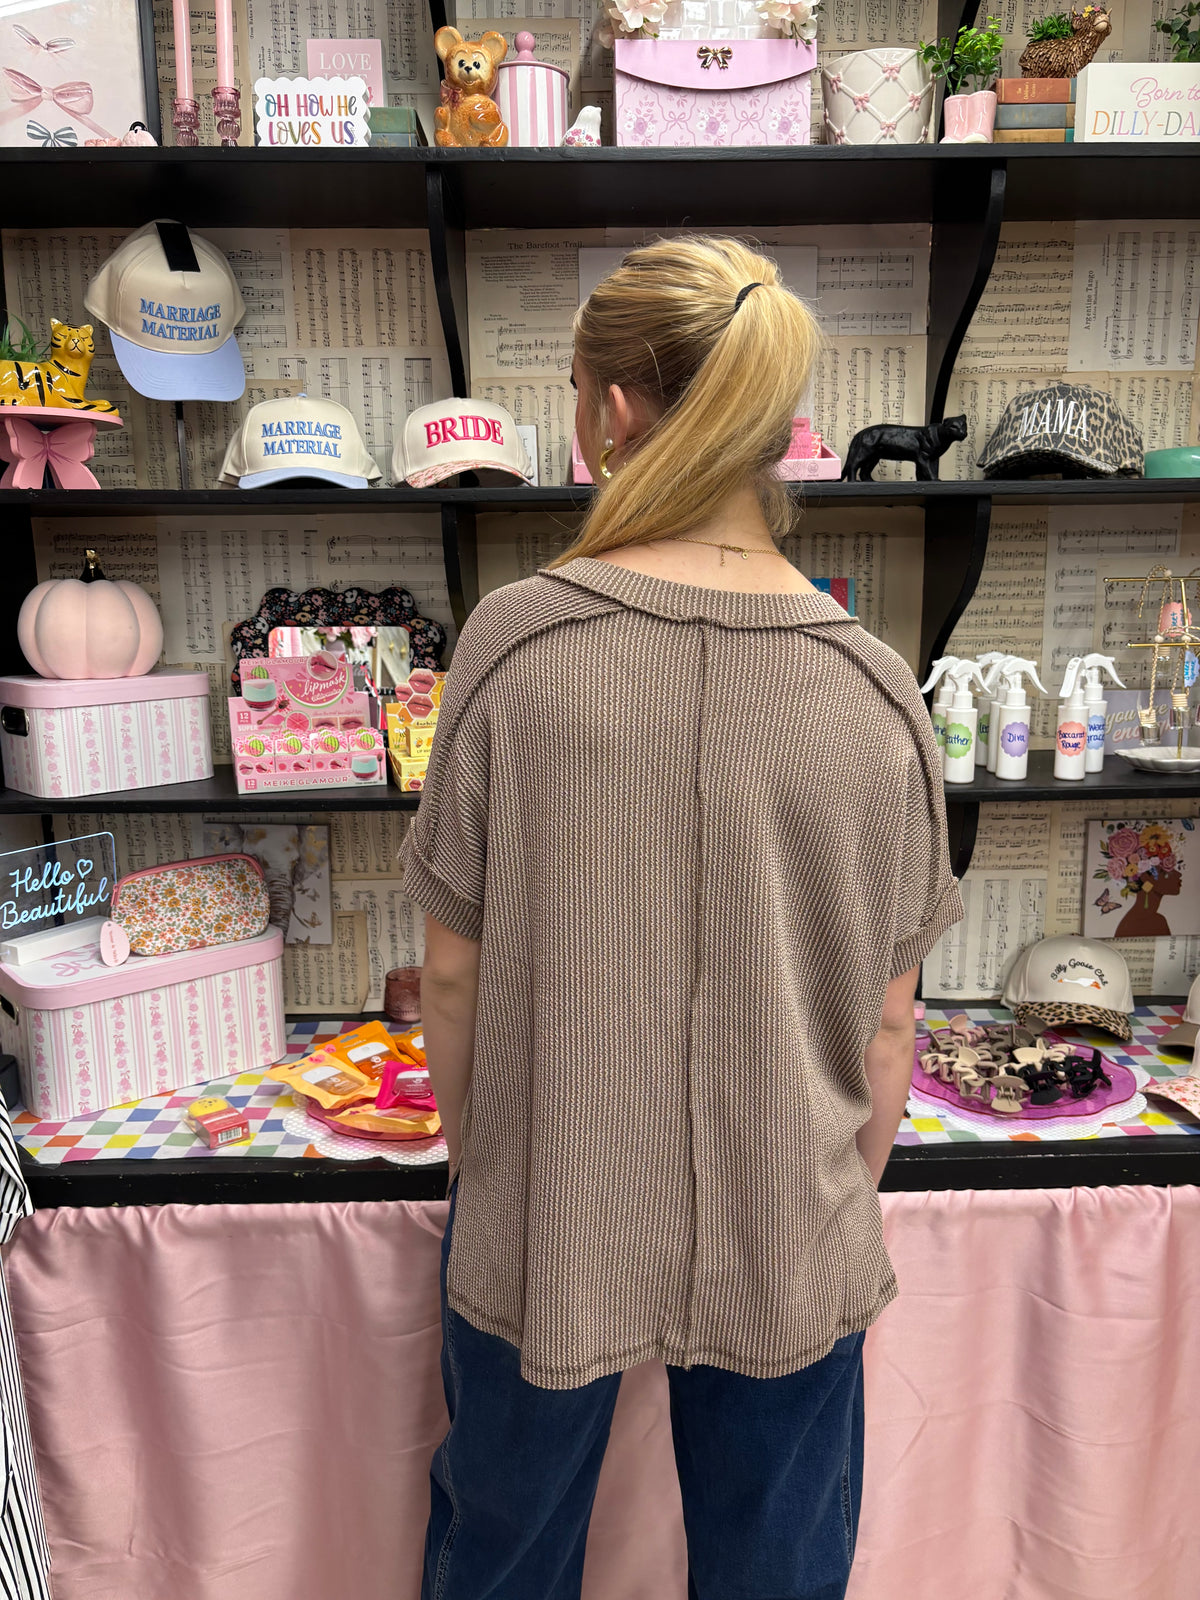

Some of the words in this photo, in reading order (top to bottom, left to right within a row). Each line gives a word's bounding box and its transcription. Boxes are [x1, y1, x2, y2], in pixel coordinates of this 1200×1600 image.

[319, 52, 372, 71] LOVE
[1129, 76, 1186, 109] Born
[1187, 83, 1200, 101] to
[265, 94, 290, 117] OH
[296, 94, 334, 117] HOW
[331, 120, 355, 145] US
[507, 242, 524, 250] The
[526, 241, 560, 249] Barefoot
[1085, 270, 1095, 292] Tango
[140, 298, 222, 323] MARRIAGE
[141, 319, 220, 341] MATERIAL
[261, 420, 342, 440] MARRIAGE
[1016, 398, 1091, 443] MAMA
[424, 415, 504, 449] BRIDE
[263, 440, 341, 459] MATERIAL
[1105, 709, 1136, 734] you
[1007, 732, 1026, 743] Diva
[1061, 740, 1081, 751] Rouge
[298, 776, 348, 785] GLAMOUR
[8, 861, 75, 898] Hello
[0, 876, 110, 930] Beautiful
[1068, 958, 1094, 970] Goose
